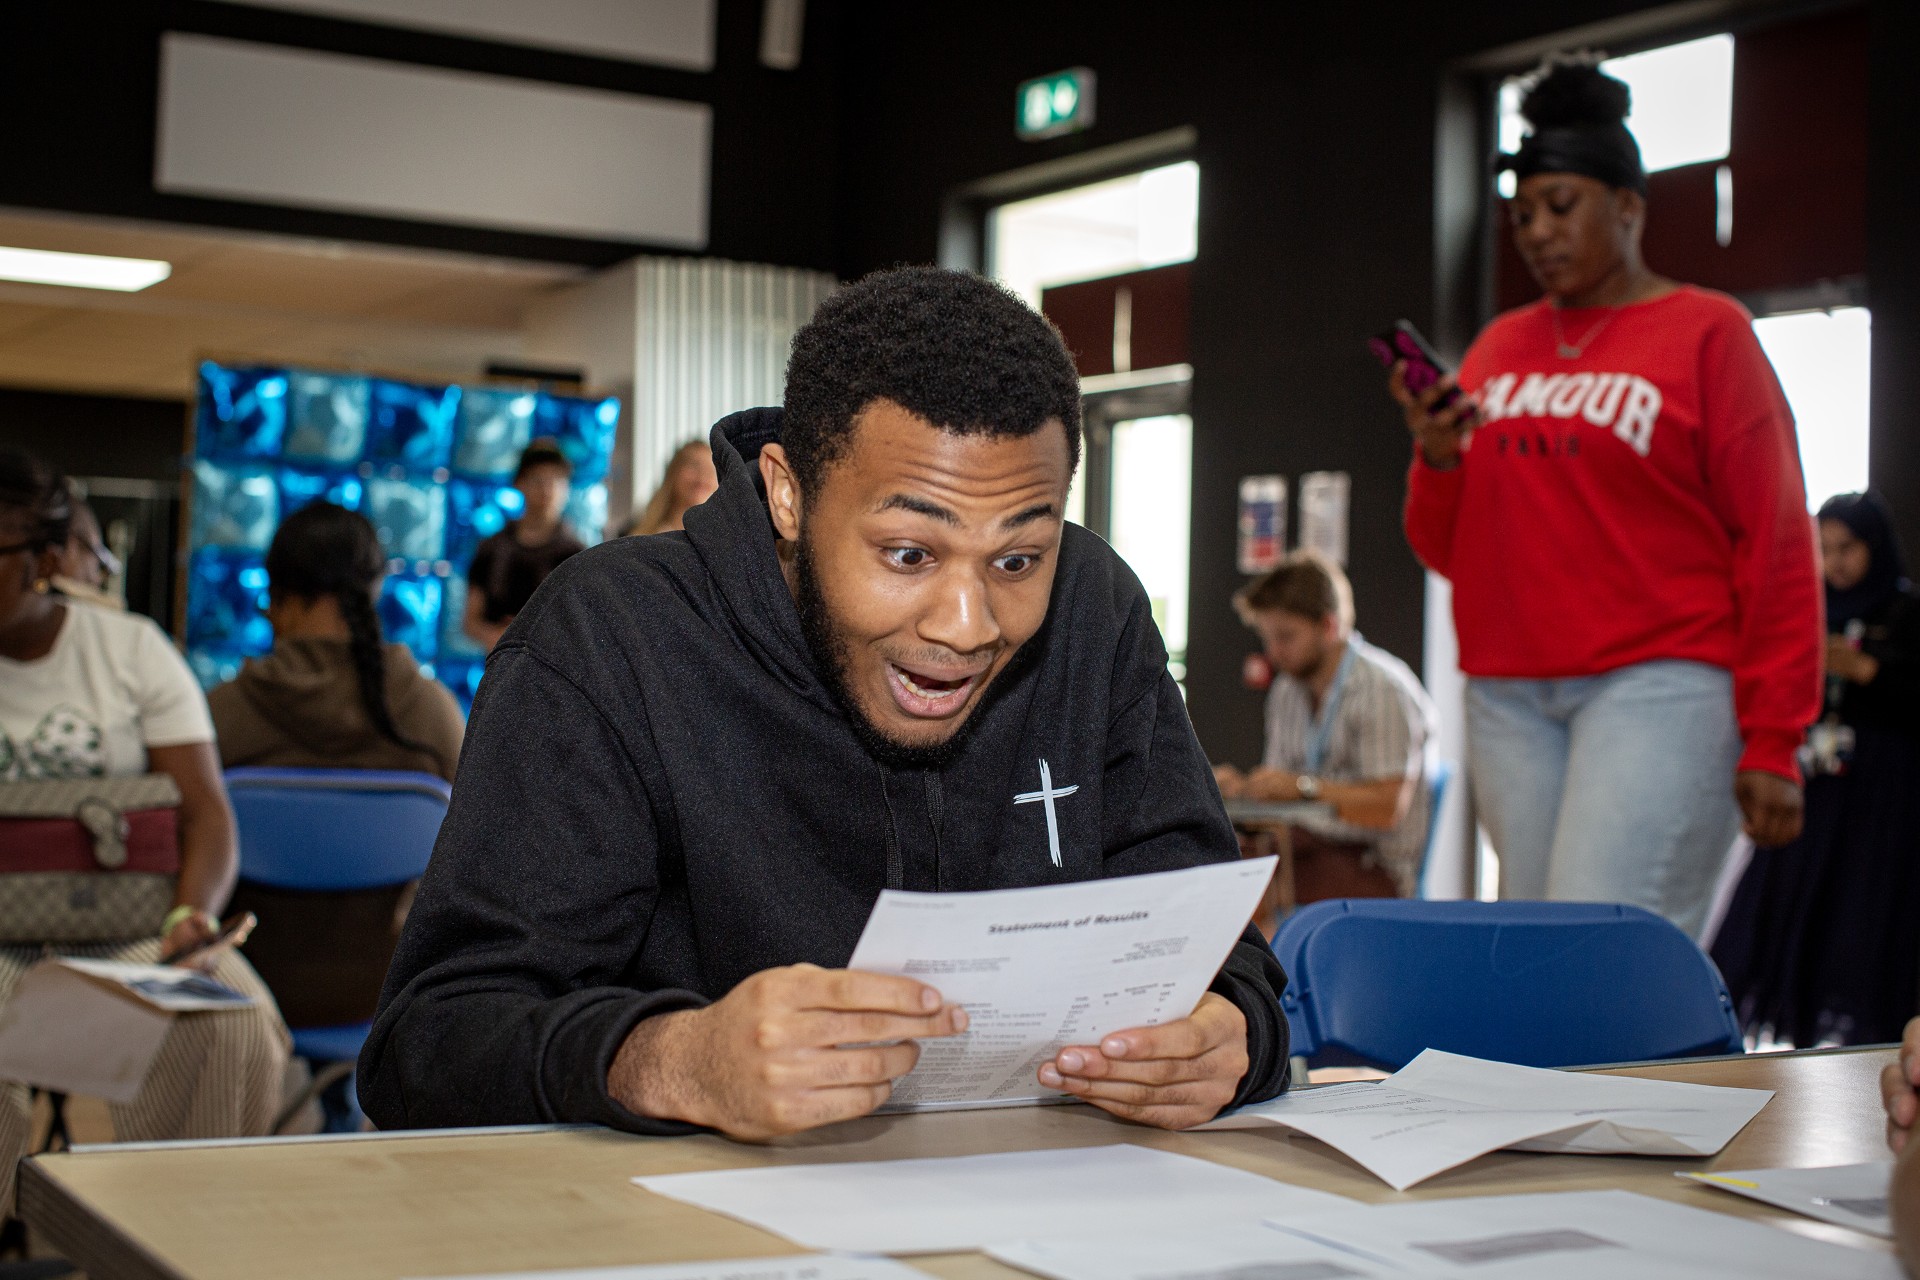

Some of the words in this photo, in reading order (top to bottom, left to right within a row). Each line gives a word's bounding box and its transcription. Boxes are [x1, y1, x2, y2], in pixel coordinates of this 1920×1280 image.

[1460, 371, 1663, 457] AMOUR
[988, 920, 1069, 934] Statement
[1074, 916, 1091, 927] of
[1094, 910, 1148, 924] Results
